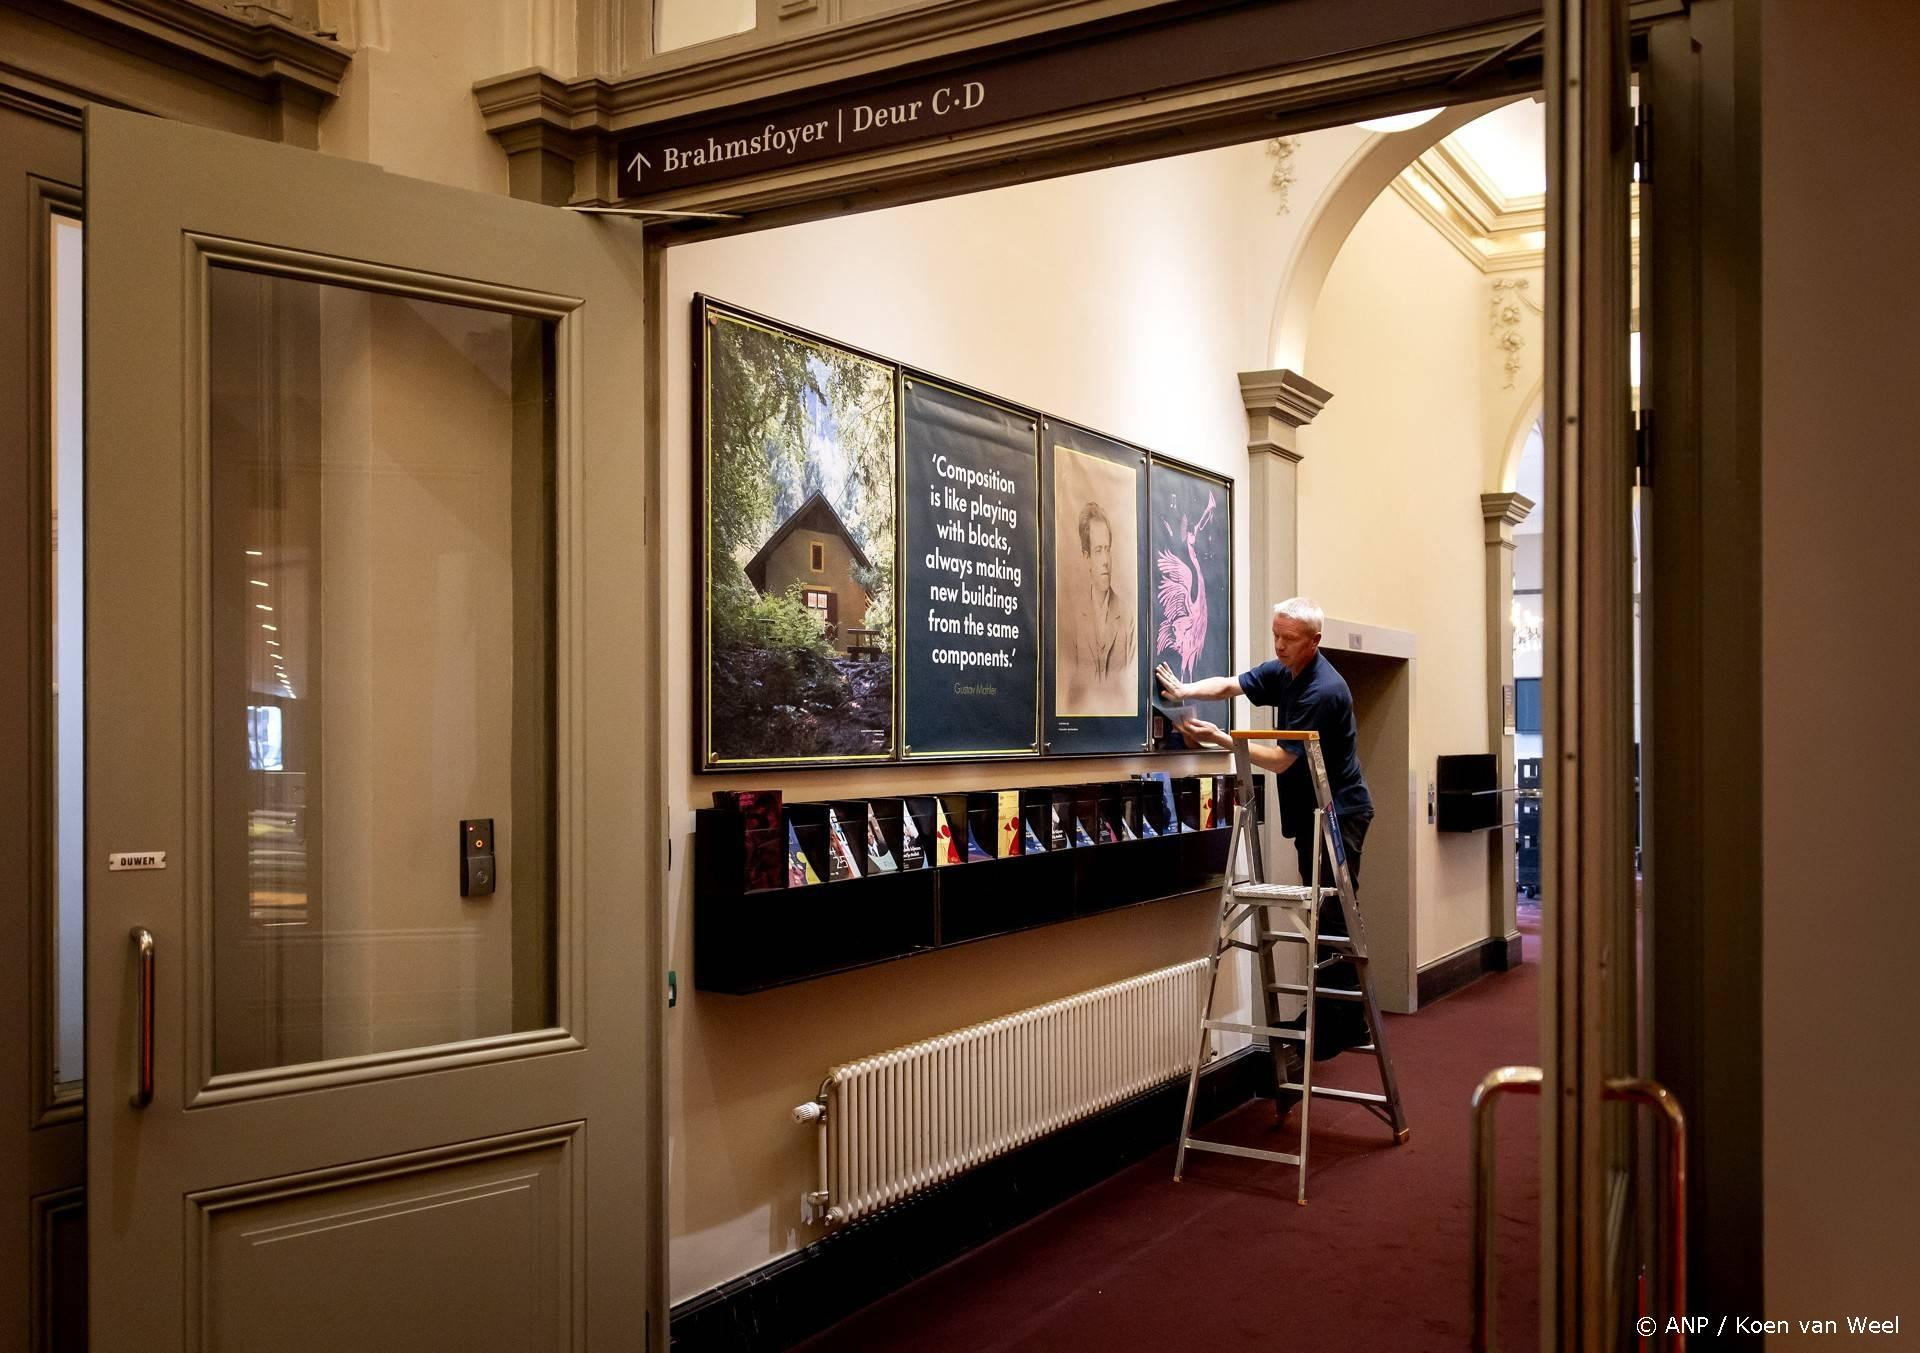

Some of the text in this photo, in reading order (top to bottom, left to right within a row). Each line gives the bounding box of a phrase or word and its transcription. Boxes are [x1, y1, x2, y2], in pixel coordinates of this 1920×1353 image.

[663, 120, 829, 172] Brahmsfoyer
[852, 98, 923, 133] Deur
[930, 483, 1017, 529] is like playing
[936, 519, 1012, 556] with blocks,
[925, 546, 1022, 588] always making
[930, 581, 1018, 616] new buildings
[927, 608, 1020, 640] from the same
[953, 682, 975, 696] Gustav
